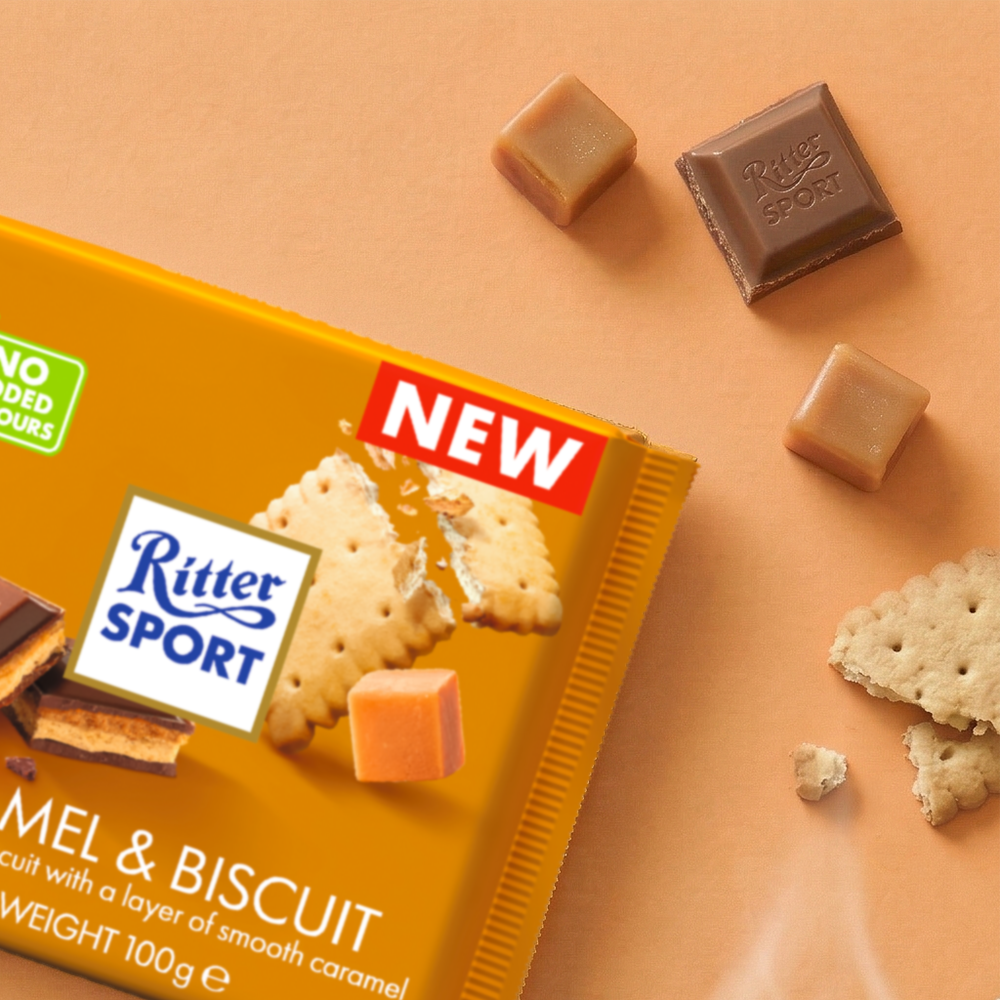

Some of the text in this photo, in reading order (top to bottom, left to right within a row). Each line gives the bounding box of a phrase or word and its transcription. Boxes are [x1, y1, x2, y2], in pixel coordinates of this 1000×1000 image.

[742, 133, 832, 203] Ritter
[762, 170, 844, 227] SPORT
[381, 380, 584, 491] NEW
[116, 530, 287, 630] Ritter
[100, 602, 266, 686] SPORT
[0, 891, 120, 954] WEIGHT
[125, 934, 195, 989] 100g
[46, 864, 93, 894] with
[99, 885, 116, 902] a
[122, 883, 184, 924] layer
[188, 911, 218, 935] of
[217, 925, 304, 966] smooth
[310, 957, 410, 1000] caramel
[116, 829, 156, 882] &
[170, 845, 383, 952] BISCUIT
